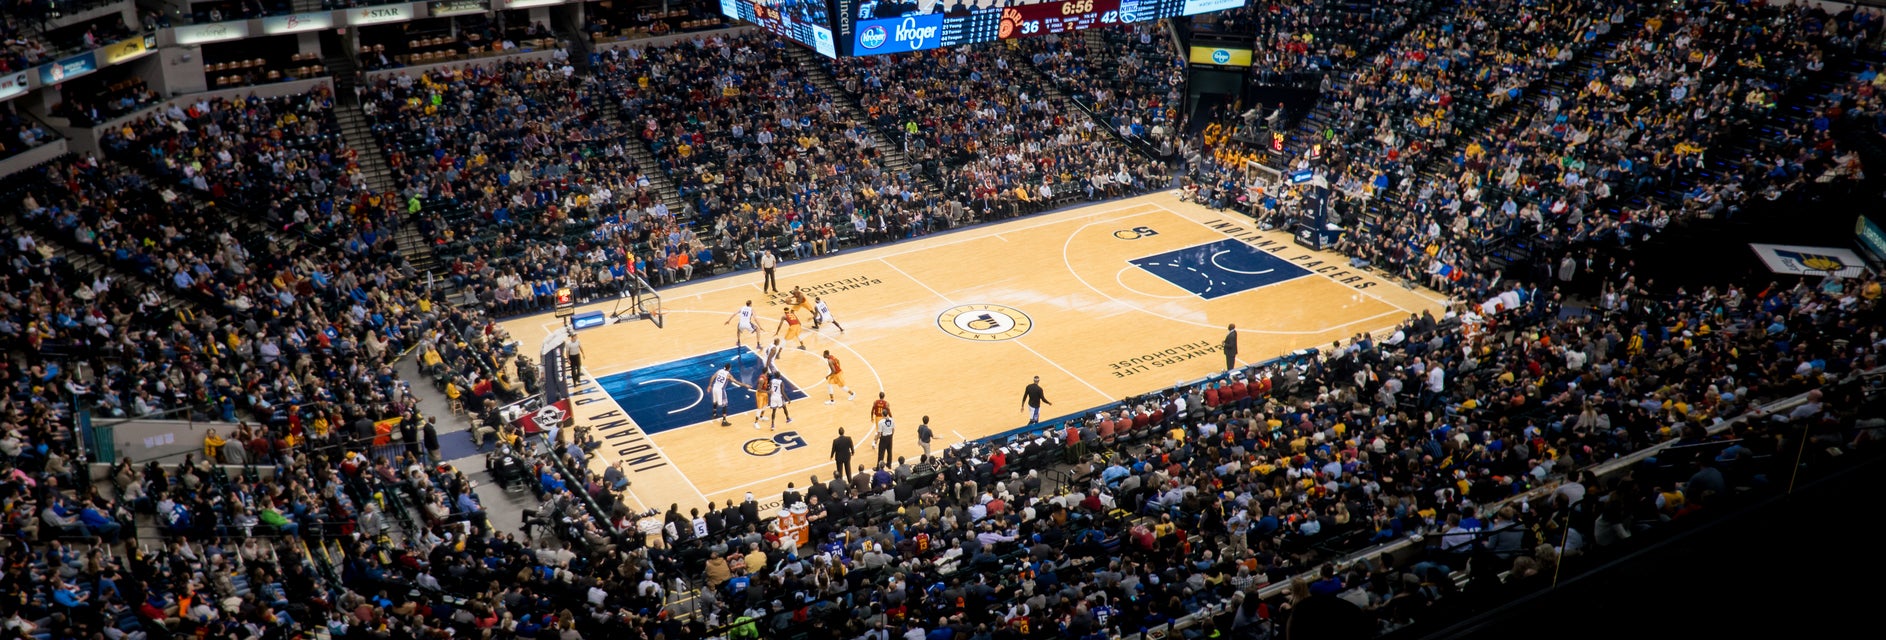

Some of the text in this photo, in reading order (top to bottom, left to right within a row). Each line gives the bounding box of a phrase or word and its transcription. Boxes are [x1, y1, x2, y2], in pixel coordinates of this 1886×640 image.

[371, 7, 399, 18] STAR
[1062, 0, 1093, 15] 6:56
[1101, 11, 1118, 23] 42
[896, 17, 937, 49] Kroger
[1021, 21, 1040, 34] 36
[1067, 22, 1073, 30] 2
[1204, 219, 1288, 253] INDIANA
[1289, 254, 1377, 290] PACERS
[806, 278, 882, 298] BANKERS
[1108, 340, 1210, 370] FIELDHOUSE
[1111, 343, 1225, 379] BANKERS LIFE
[716, 374, 726, 384] 22
[588, 409, 668, 473] INDIANA
[698, 525, 705, 534] 5
